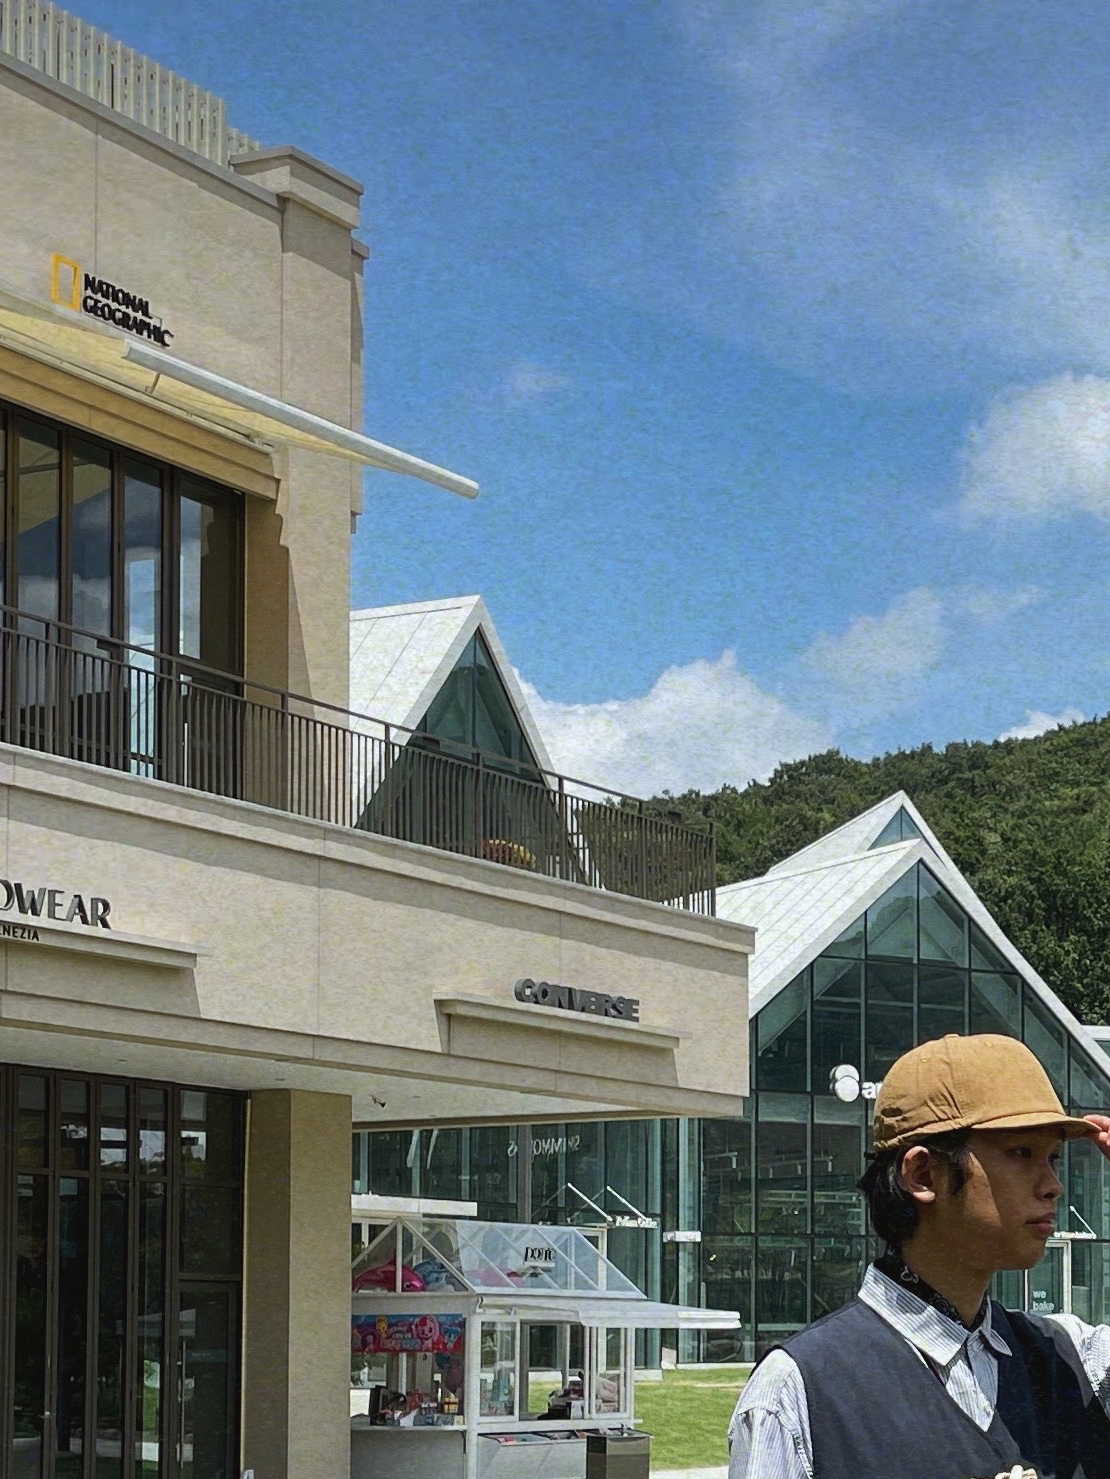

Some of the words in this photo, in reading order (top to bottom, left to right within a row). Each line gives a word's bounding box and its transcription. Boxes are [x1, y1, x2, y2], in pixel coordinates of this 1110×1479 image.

[84, 273, 153, 320] NATIONAL
[82, 295, 175, 348] GEOGRAPHIC
[0, 923, 40, 942] NEZIA
[514, 978, 640, 1023] CONVERSE
[1032, 1290, 1047, 1299] we
[1032, 1300, 1055, 1311] bake
